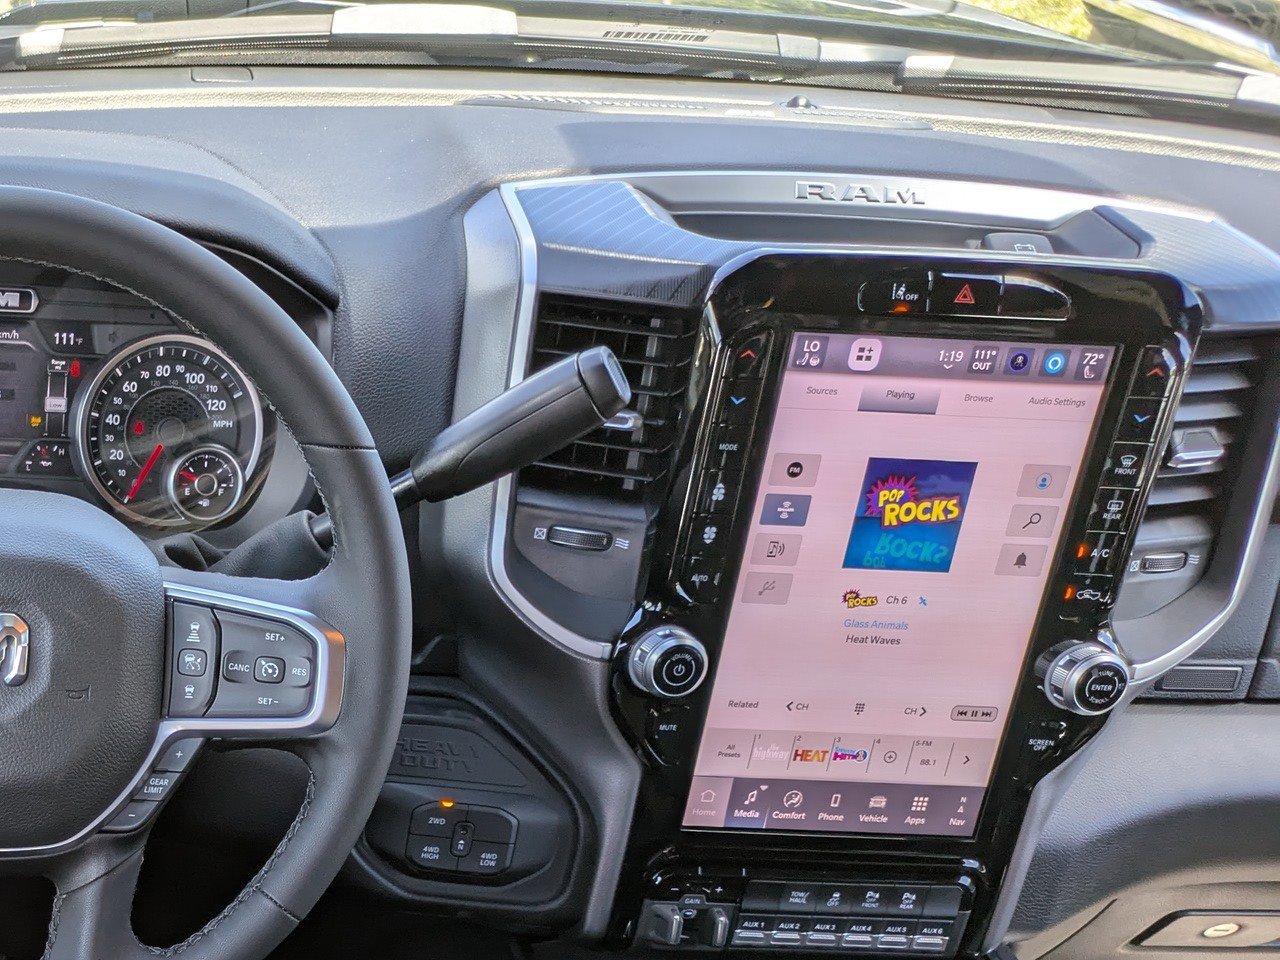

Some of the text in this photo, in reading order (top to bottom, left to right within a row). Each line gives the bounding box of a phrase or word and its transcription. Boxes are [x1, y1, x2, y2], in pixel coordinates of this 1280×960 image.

[794, 181, 926, 205] RAM
[905, 293, 919, 301] OFF
[803, 340, 821, 352] LO
[937, 350, 965, 363] 1:19
[1082, 353, 1106, 366] 72°
[51, 359, 66, 367] Range
[972, 362, 992, 371] OUT
[155, 365, 171, 377] 80
[175, 365, 185, 374] 90
[140, 371, 150, 379] 70
[185, 373, 205, 385] 100
[122, 381, 138, 393] 60
[205, 384, 218, 393] 110
[806, 386, 838, 396] Sources
[885, 389, 916, 401] Playing
[964, 393, 994, 403] Browse
[113, 397, 123, 406] 50
[206, 400, 227, 411] 120
[1028, 396, 1086, 408] Audio Settings
[106, 414, 120, 426] 40
[212, 420, 233, 428] MPH
[105, 434, 114, 443] 30
[719, 443, 738, 451] MODE
[58, 448, 65, 456] H
[109, 449, 124, 460] 20
[118, 469, 127, 477] 10
[788, 466, 801, 474] FM
[1114, 467, 1137, 476] FRONT
[184, 487, 191, 496] E
[218, 488, 224, 496] F
[878, 488, 906, 508] POP
[882, 498, 960, 527] ROCKS
[1102, 512, 1122, 520] REAR
[1090, 549, 1110, 558] A/C
[691, 574, 709, 582] AUTO
[847, 595, 908, 608] ROCKS Ch 6
[843, 618, 909, 631] Glass Animals
[265, 632, 285, 642] SET+
[845, 634, 901, 646] Heat Waves
[671, 653, 693, 661] VOLUME
[228, 662, 250, 673] CANC
[291, 667, 307, 676] RES
[728, 700, 760, 710] Related
[795, 703, 810, 711] CH
[904, 707, 918, 716] CH
[659, 724, 678, 732] MUTE
[1028, 738, 1055, 747] SCREEN
[718, 751, 741, 759] Presets
[792, 749, 829, 762] HEAT
[149, 778, 169, 786] GEAR
[692, 808, 717, 817] Home
[733, 810, 760, 818] Media
[772, 811, 806, 820] Comfort
[818, 812, 844, 822] Phone
[428, 817, 446, 825] 2WD
[859, 814, 889, 823] Vehicle
[904, 816, 926, 825] Apps
[949, 817, 966, 826] Nav
[421, 852, 440, 860] HIGH
[480, 852, 498, 860] 4WD
[480, 859, 496, 867] LOW
